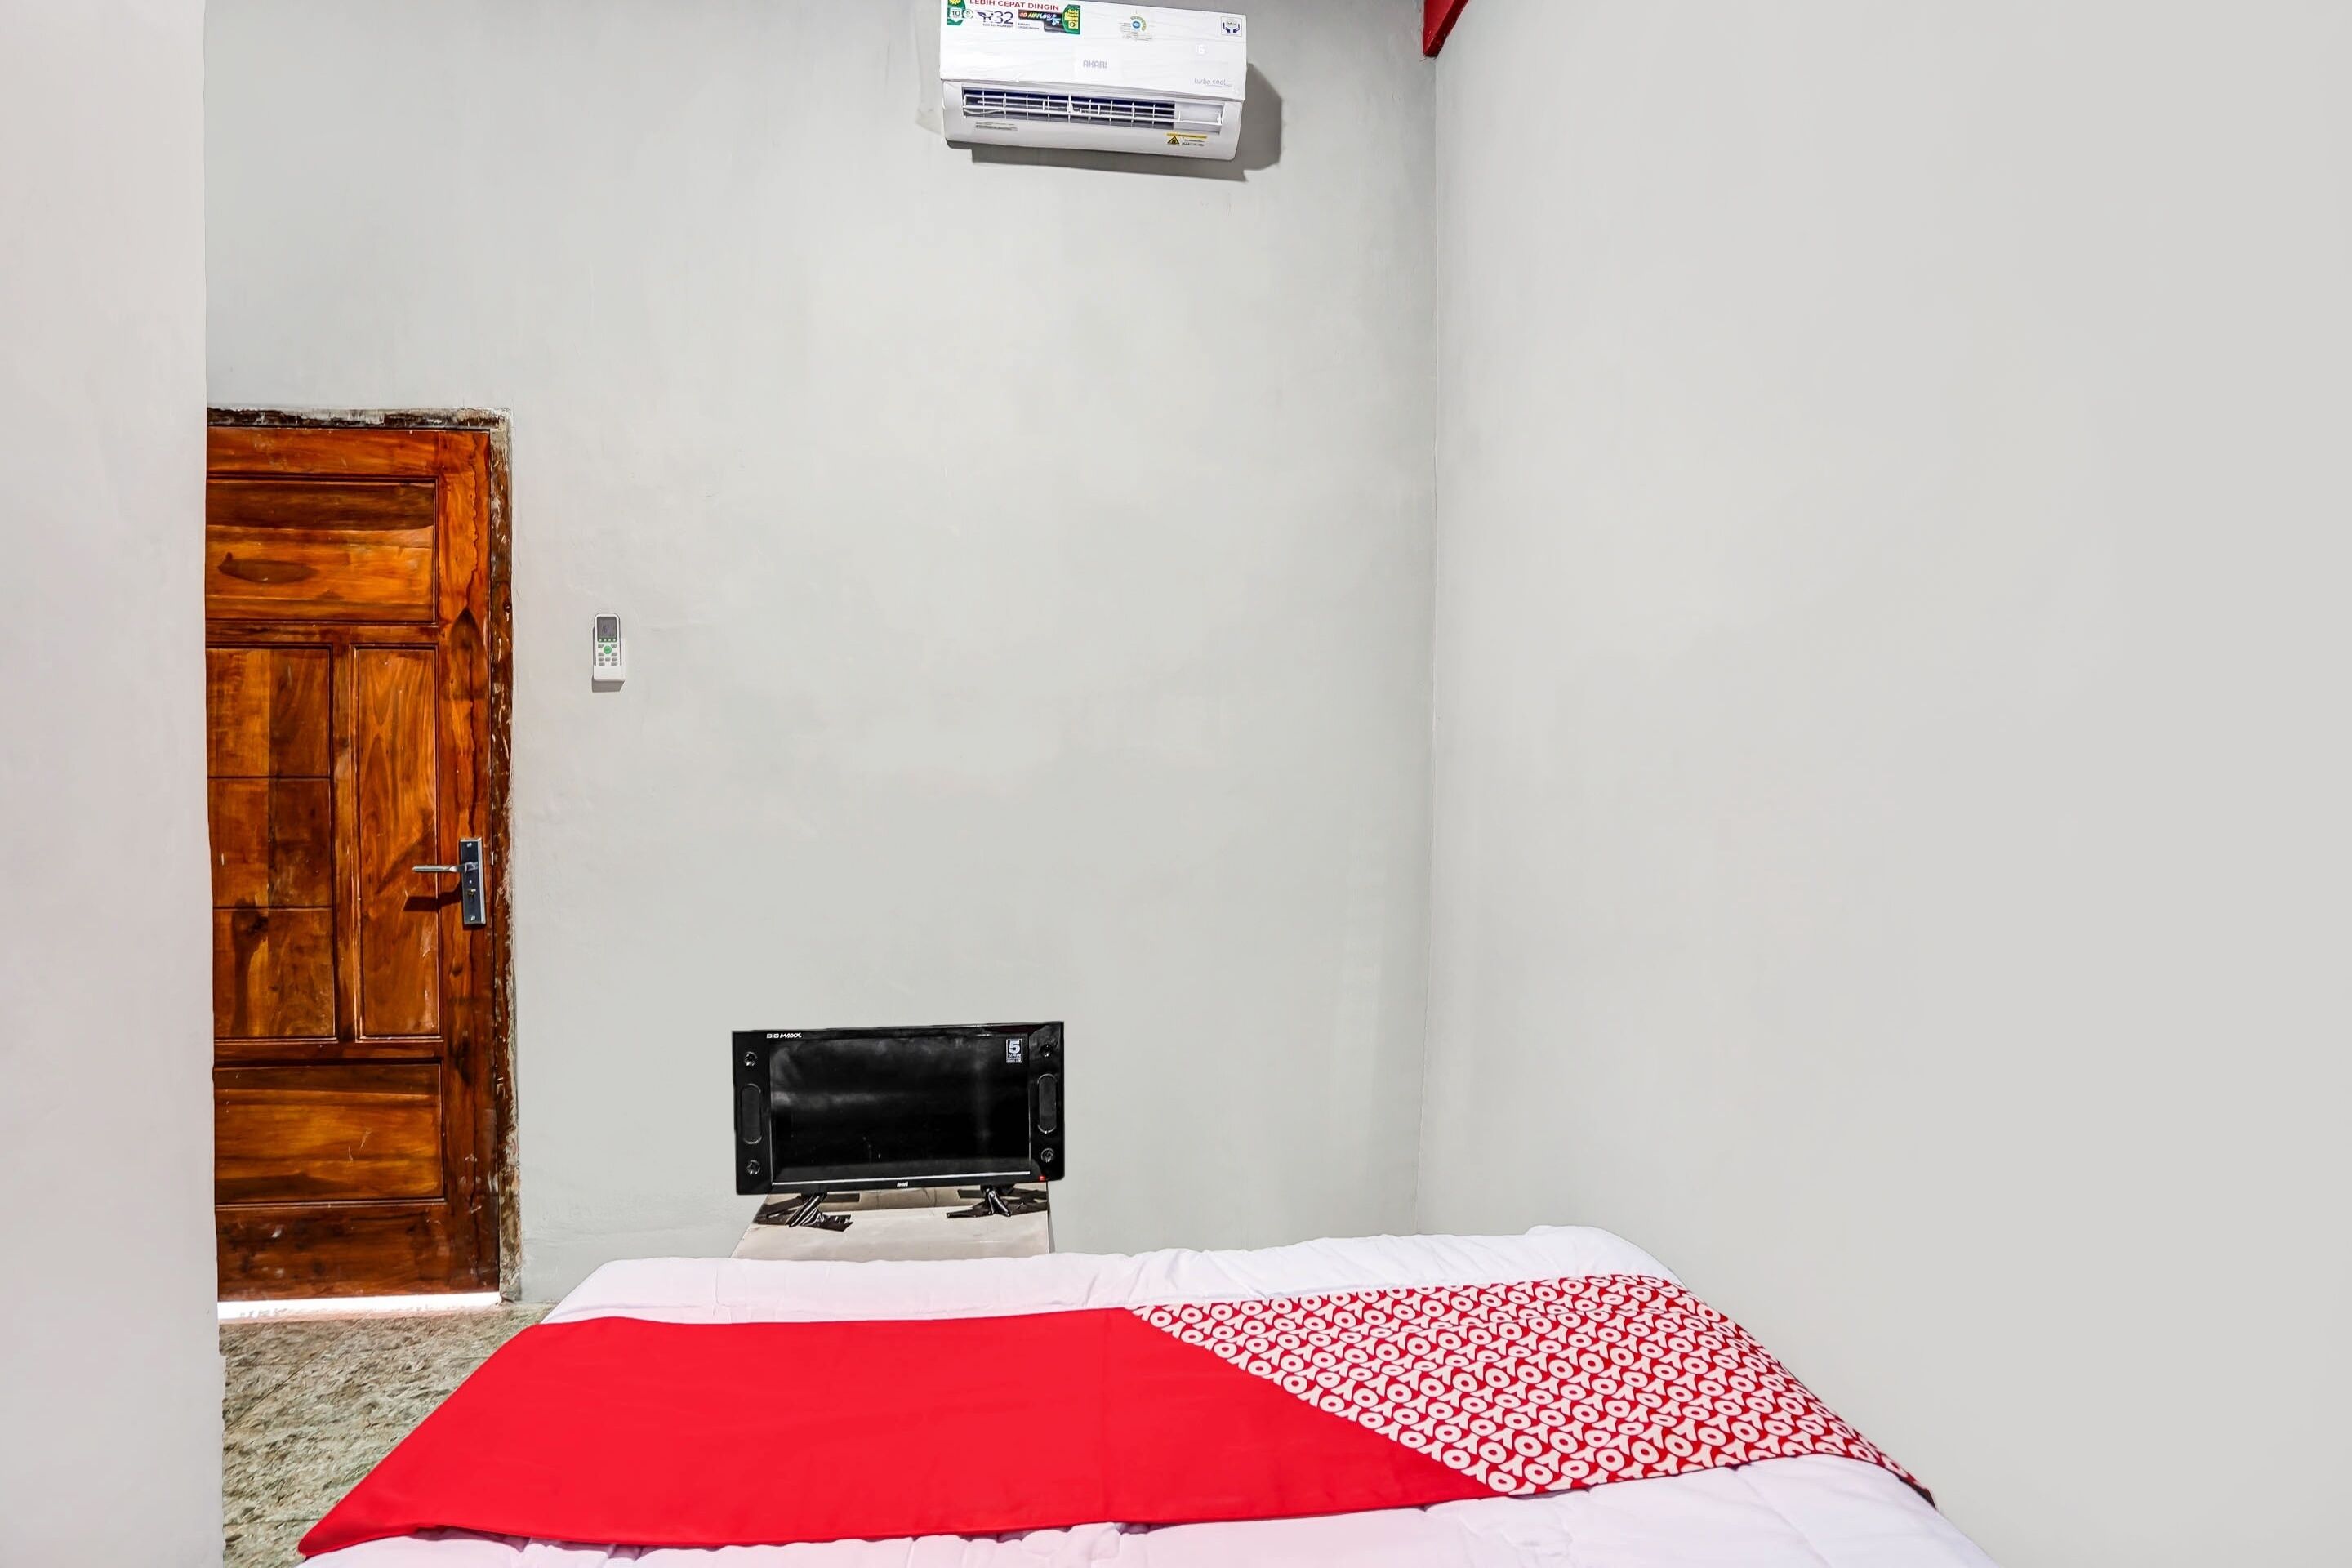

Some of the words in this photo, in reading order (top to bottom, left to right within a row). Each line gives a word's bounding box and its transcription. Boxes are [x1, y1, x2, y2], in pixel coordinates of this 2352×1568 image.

[997, 0, 1026, 8] CEPAT
[1027, 2, 1059, 11] DINGIN
[1009, 1040, 1021, 1054] 5
